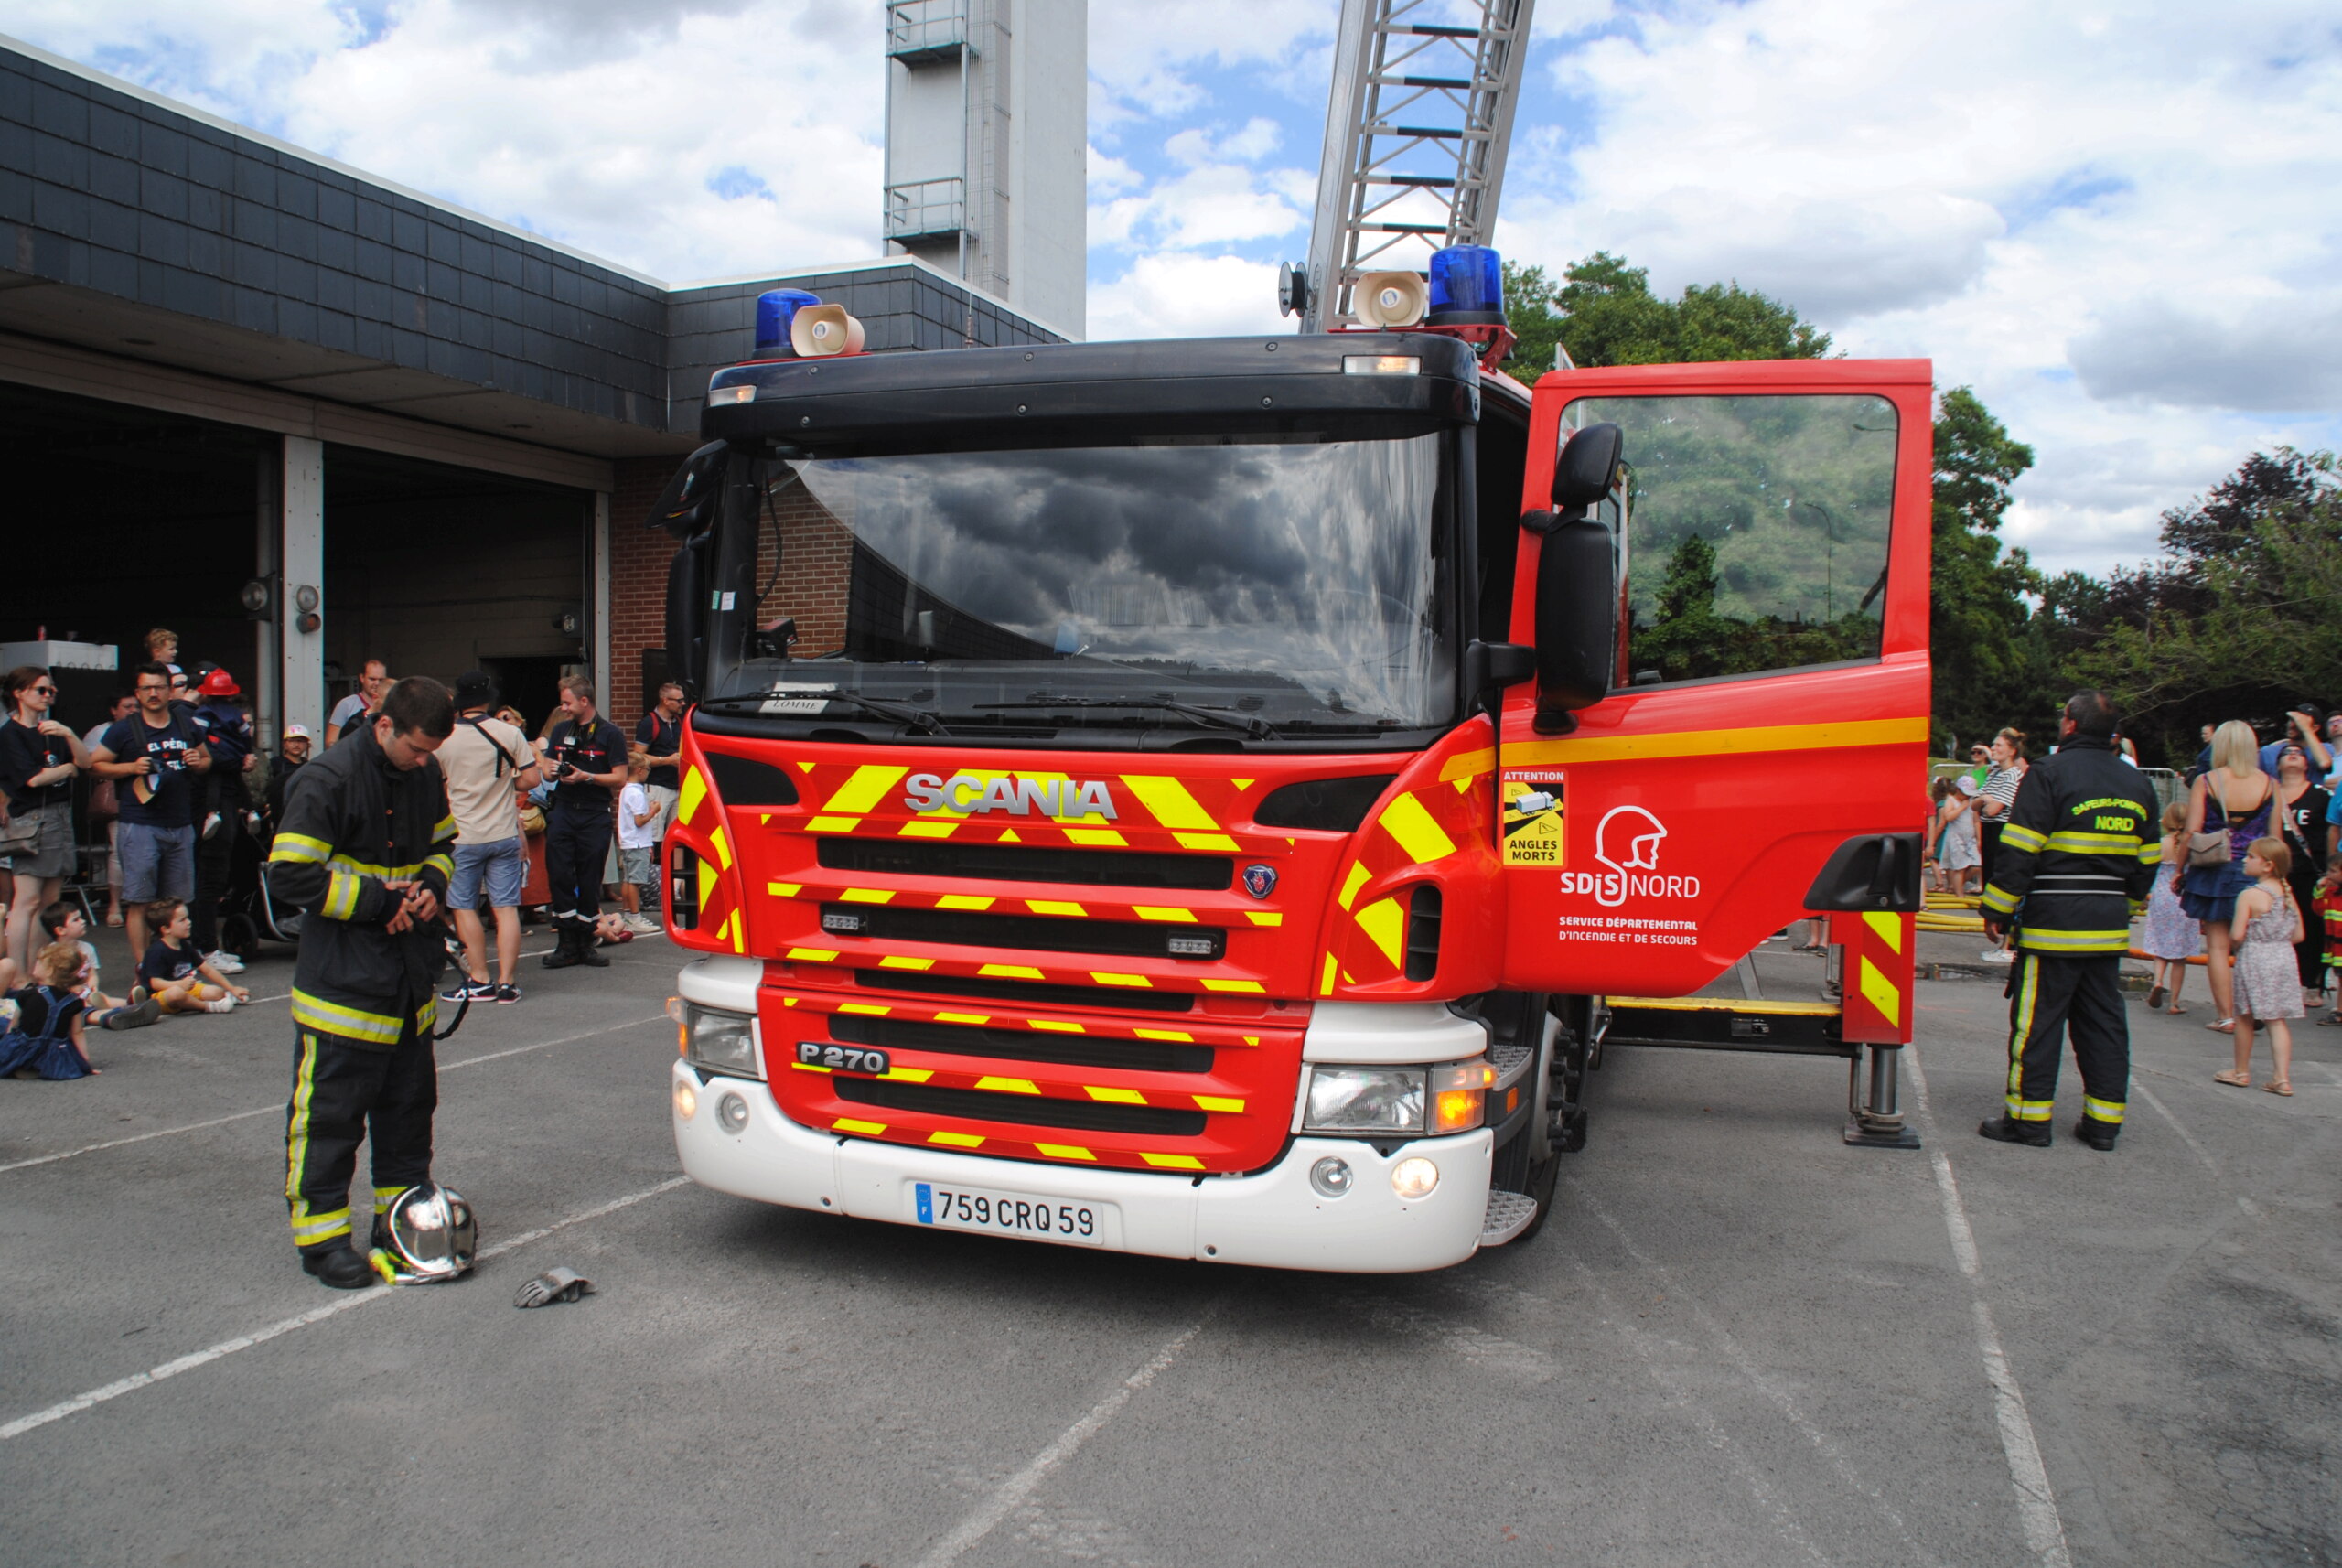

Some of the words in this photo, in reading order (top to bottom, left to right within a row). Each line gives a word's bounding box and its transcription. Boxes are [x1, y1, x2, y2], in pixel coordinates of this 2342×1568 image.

[773, 700, 818, 710] LOMME
[147, 742, 161, 752] EL
[1503, 771, 1564, 780] ATTENTION
[904, 773, 1118, 819] SCANIA
[2095, 815, 2135, 832] NORD
[1509, 840, 1558, 850] ANGLES
[1512, 851, 1555, 861] MORTS
[1630, 875, 1700, 898] NORD
[1559, 916, 1604, 927] SERVICE
[1606, 917, 1699, 930] DÉPARTEMENTAL
[1559, 930, 1616, 942] D'INCENDIE
[1618, 933, 1631, 943] ET
[1634, 934, 1648, 944] DE
[1650, 935, 1697, 946] SECOURS
[800, 1044, 820, 1063] P
[824, 1047, 884, 1072] 270
[921, 1207, 929, 1216] F
[939, 1191, 991, 1224] 759
[997, 1199, 1051, 1232] CRQ
[1058, 1206, 1094, 1236] 59
